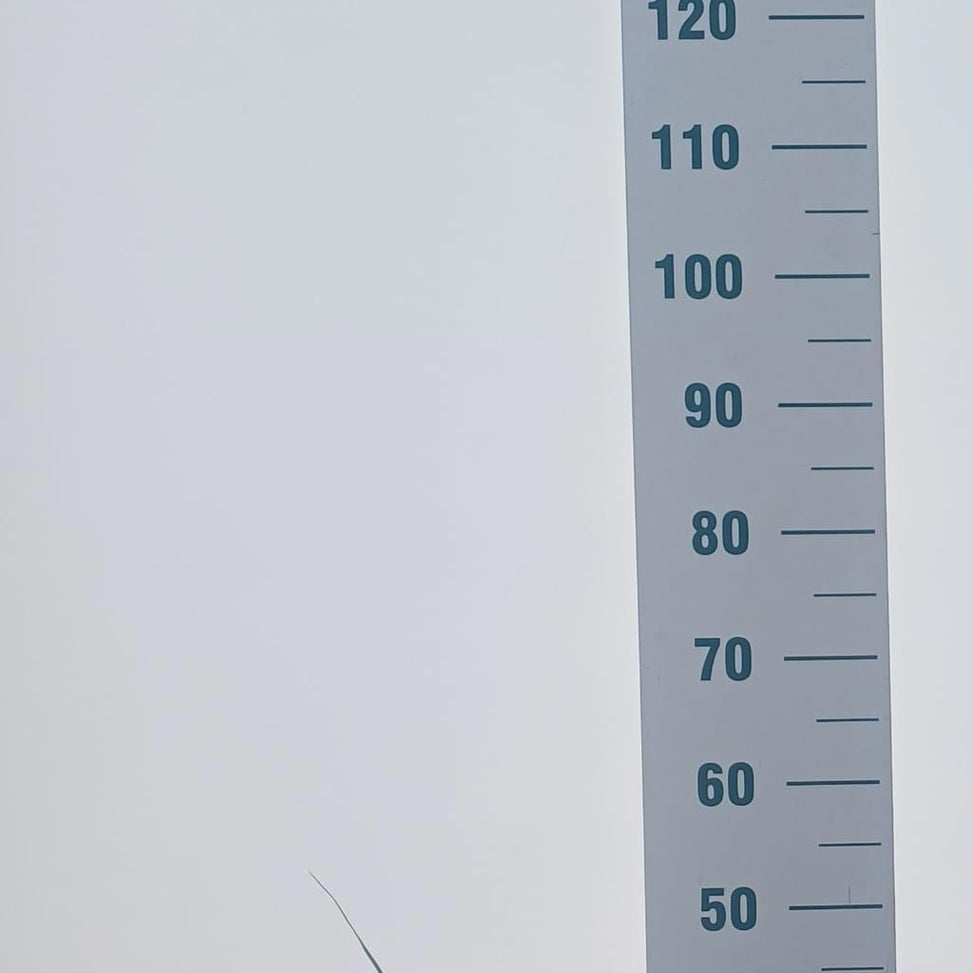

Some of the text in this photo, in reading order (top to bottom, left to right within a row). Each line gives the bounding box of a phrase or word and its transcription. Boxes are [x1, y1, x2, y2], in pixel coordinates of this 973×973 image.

[648, 0, 737, 41] 120
[651, 124, 740, 170] 110
[654, 254, 743, 300] 100
[684, 382, 743, 428] 90
[691, 510, 750, 556] 80
[694, 636, 753, 682] 70
[697, 762, 755, 807] 60
[700, 886, 758, 932] 50
